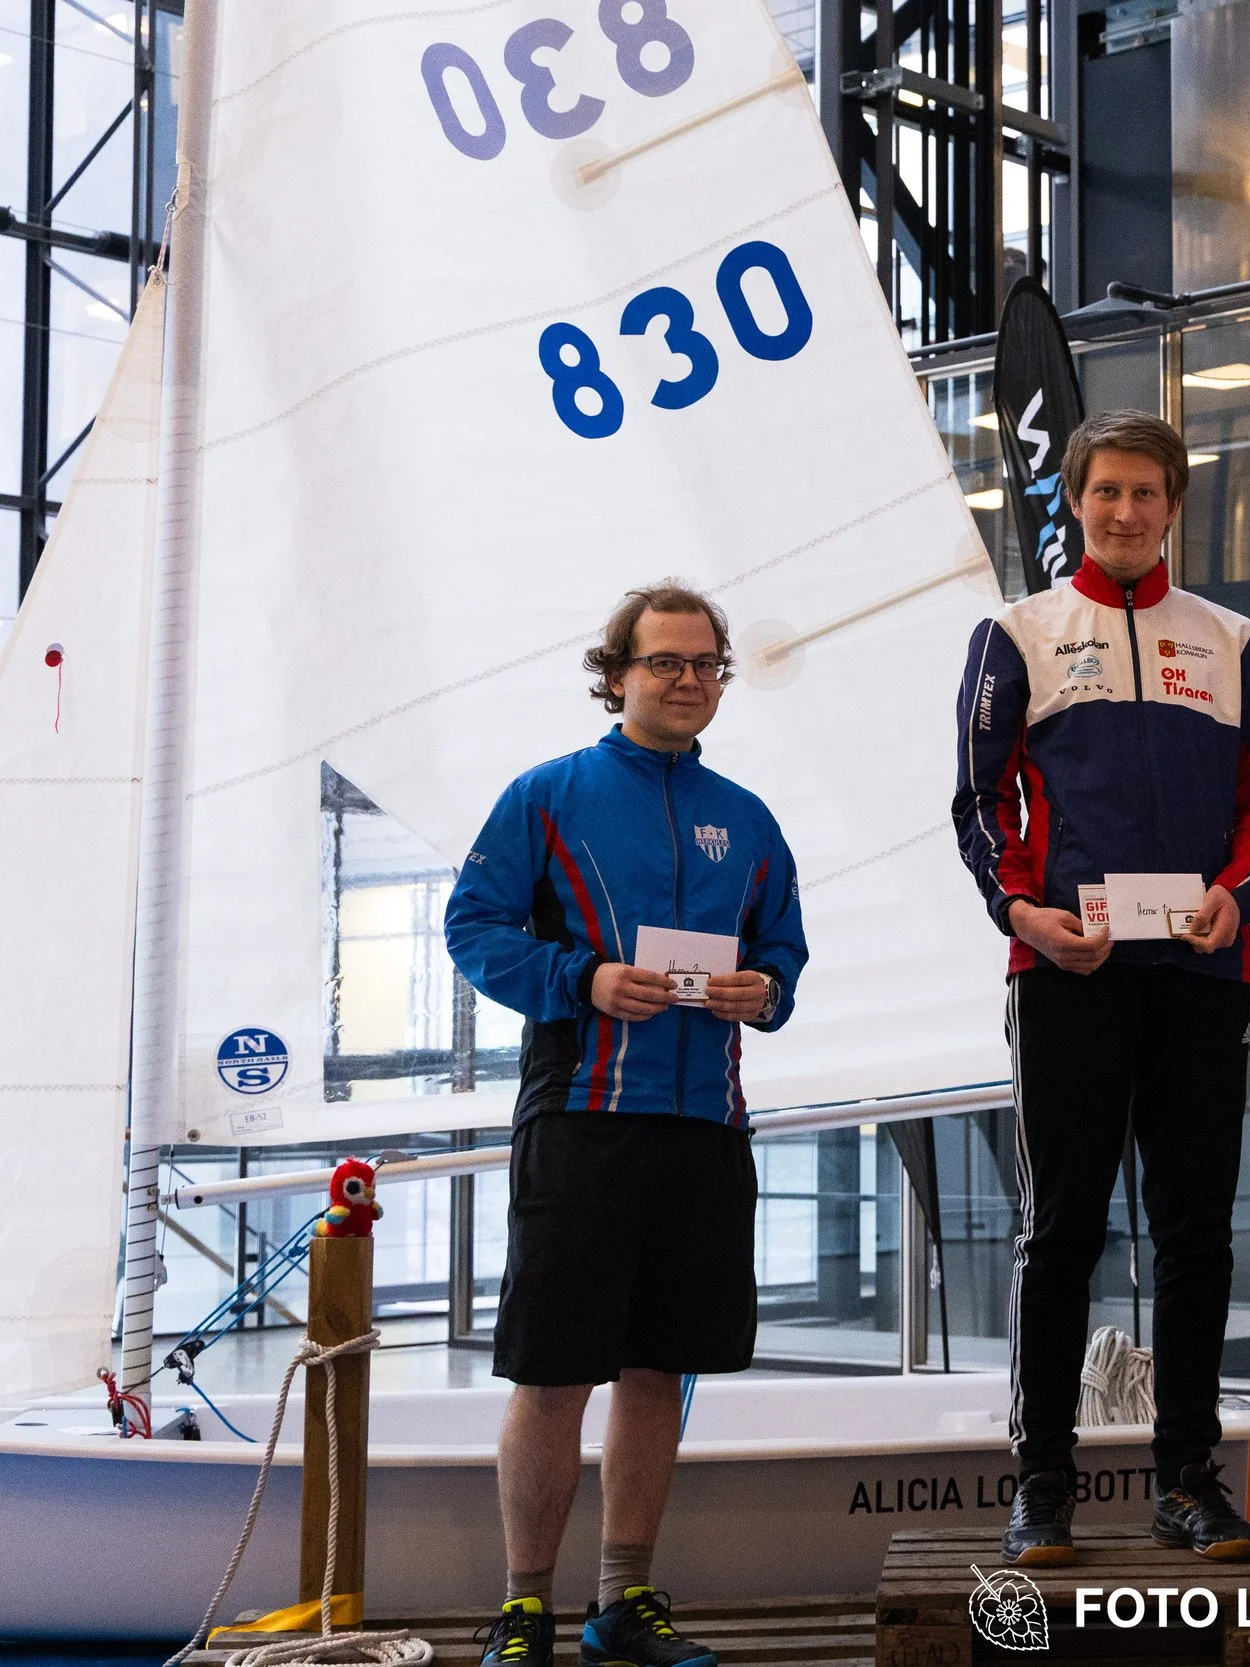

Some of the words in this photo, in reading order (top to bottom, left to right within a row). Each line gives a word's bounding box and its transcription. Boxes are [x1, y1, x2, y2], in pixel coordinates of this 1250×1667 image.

[538, 240, 813, 439] 830
[1176, 649, 1208, 659] KOMMUN
[1059, 684, 1114, 695] VOLVO
[1163, 681, 1214, 704] Tisaren
[979, 673, 996, 731] TRIMTEX
[233, 1034, 269, 1055] N
[237, 1067, 271, 1088] S
[849, 1476, 964, 1515] ALICIA
